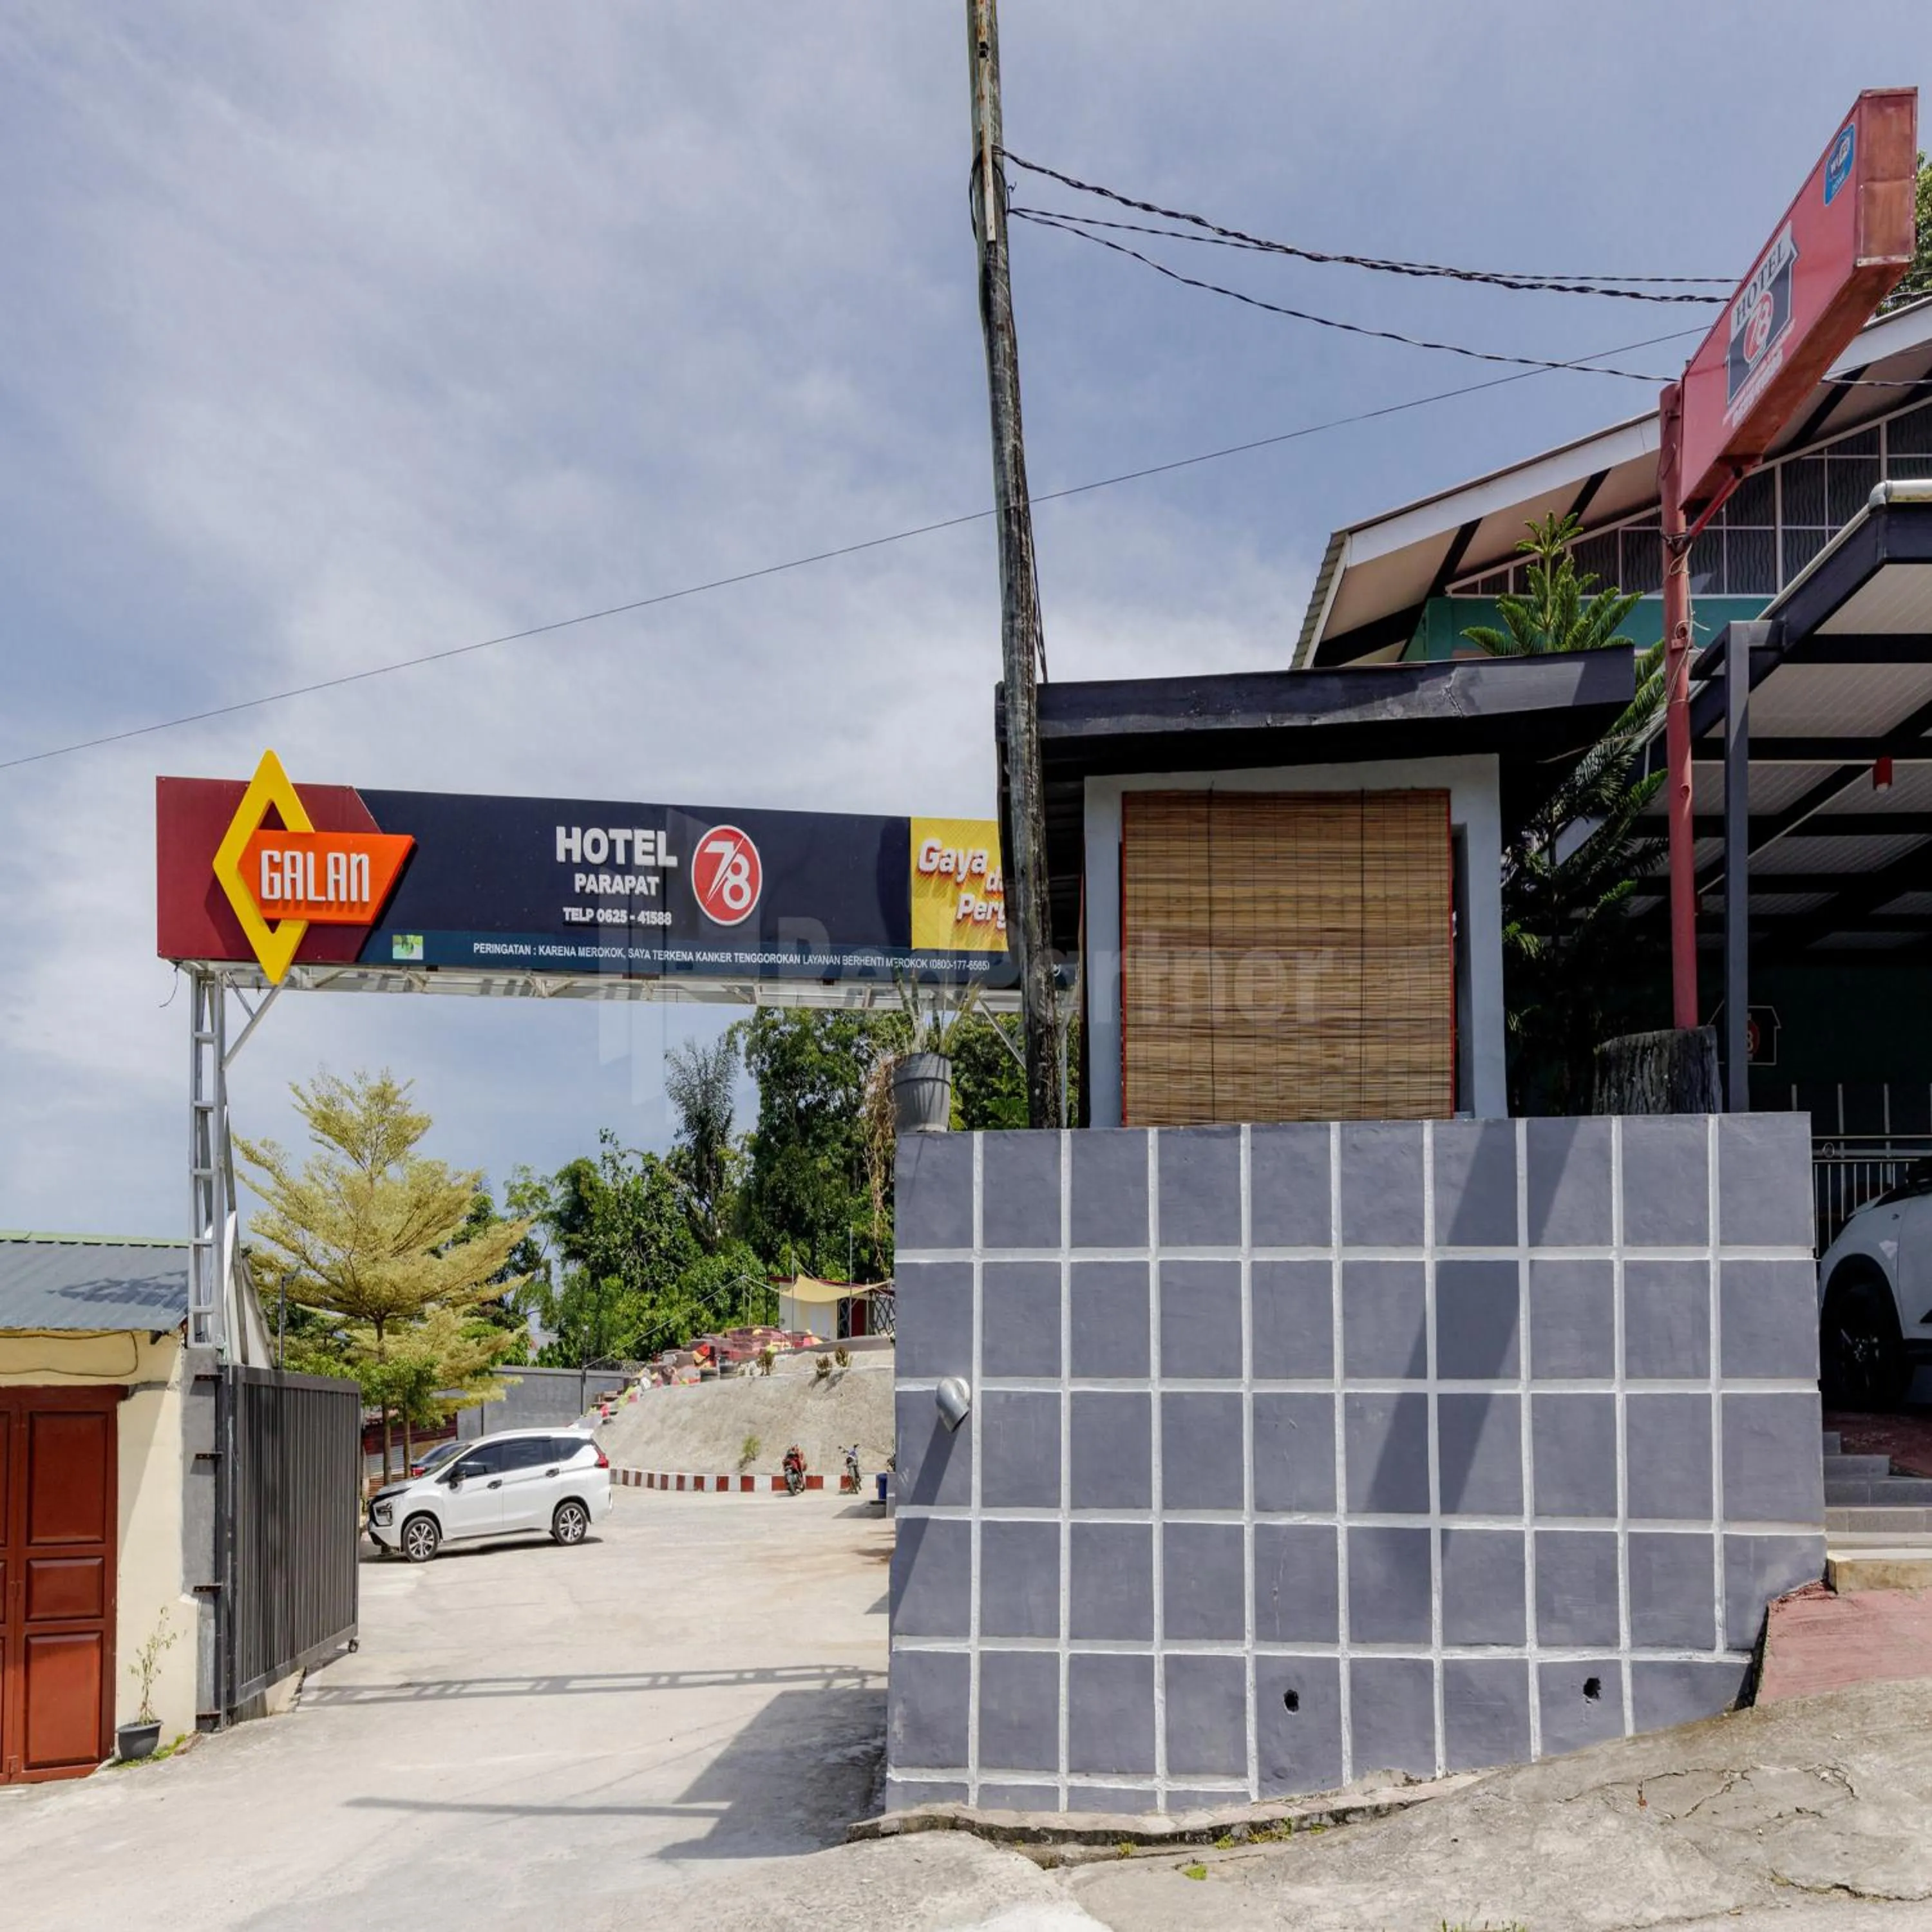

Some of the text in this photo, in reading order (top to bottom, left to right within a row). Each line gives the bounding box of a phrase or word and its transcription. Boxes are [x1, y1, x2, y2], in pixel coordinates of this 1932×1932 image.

[1736, 240, 1786, 325] HOTEL
[556, 826, 678, 867] HOTEL
[918, 838, 989, 883] Gaya
[261, 849, 370, 902] GALAN
[574, 872, 660, 896] PARAPAT
[703, 840, 752, 910] 78
[986, 865, 1003, 891] d
[562, 907, 594, 922] TELP
[596, 909, 628, 924] 0625
[637, 911, 672, 926] 41588
[473, 942, 531, 956] PERINGATAN
[538, 945, 577, 957] KARENA
[578, 946, 626, 960] MEROKOK,
[628, 947, 651, 960] SAYA
[652, 950, 694, 961] TERKENA
[695, 951, 732, 963] KANKER
[734, 952, 800, 965] TENGGOROKAN
[803, 954, 841, 965] LAYANAN
[842, 955, 884, 967] BERHENTI
